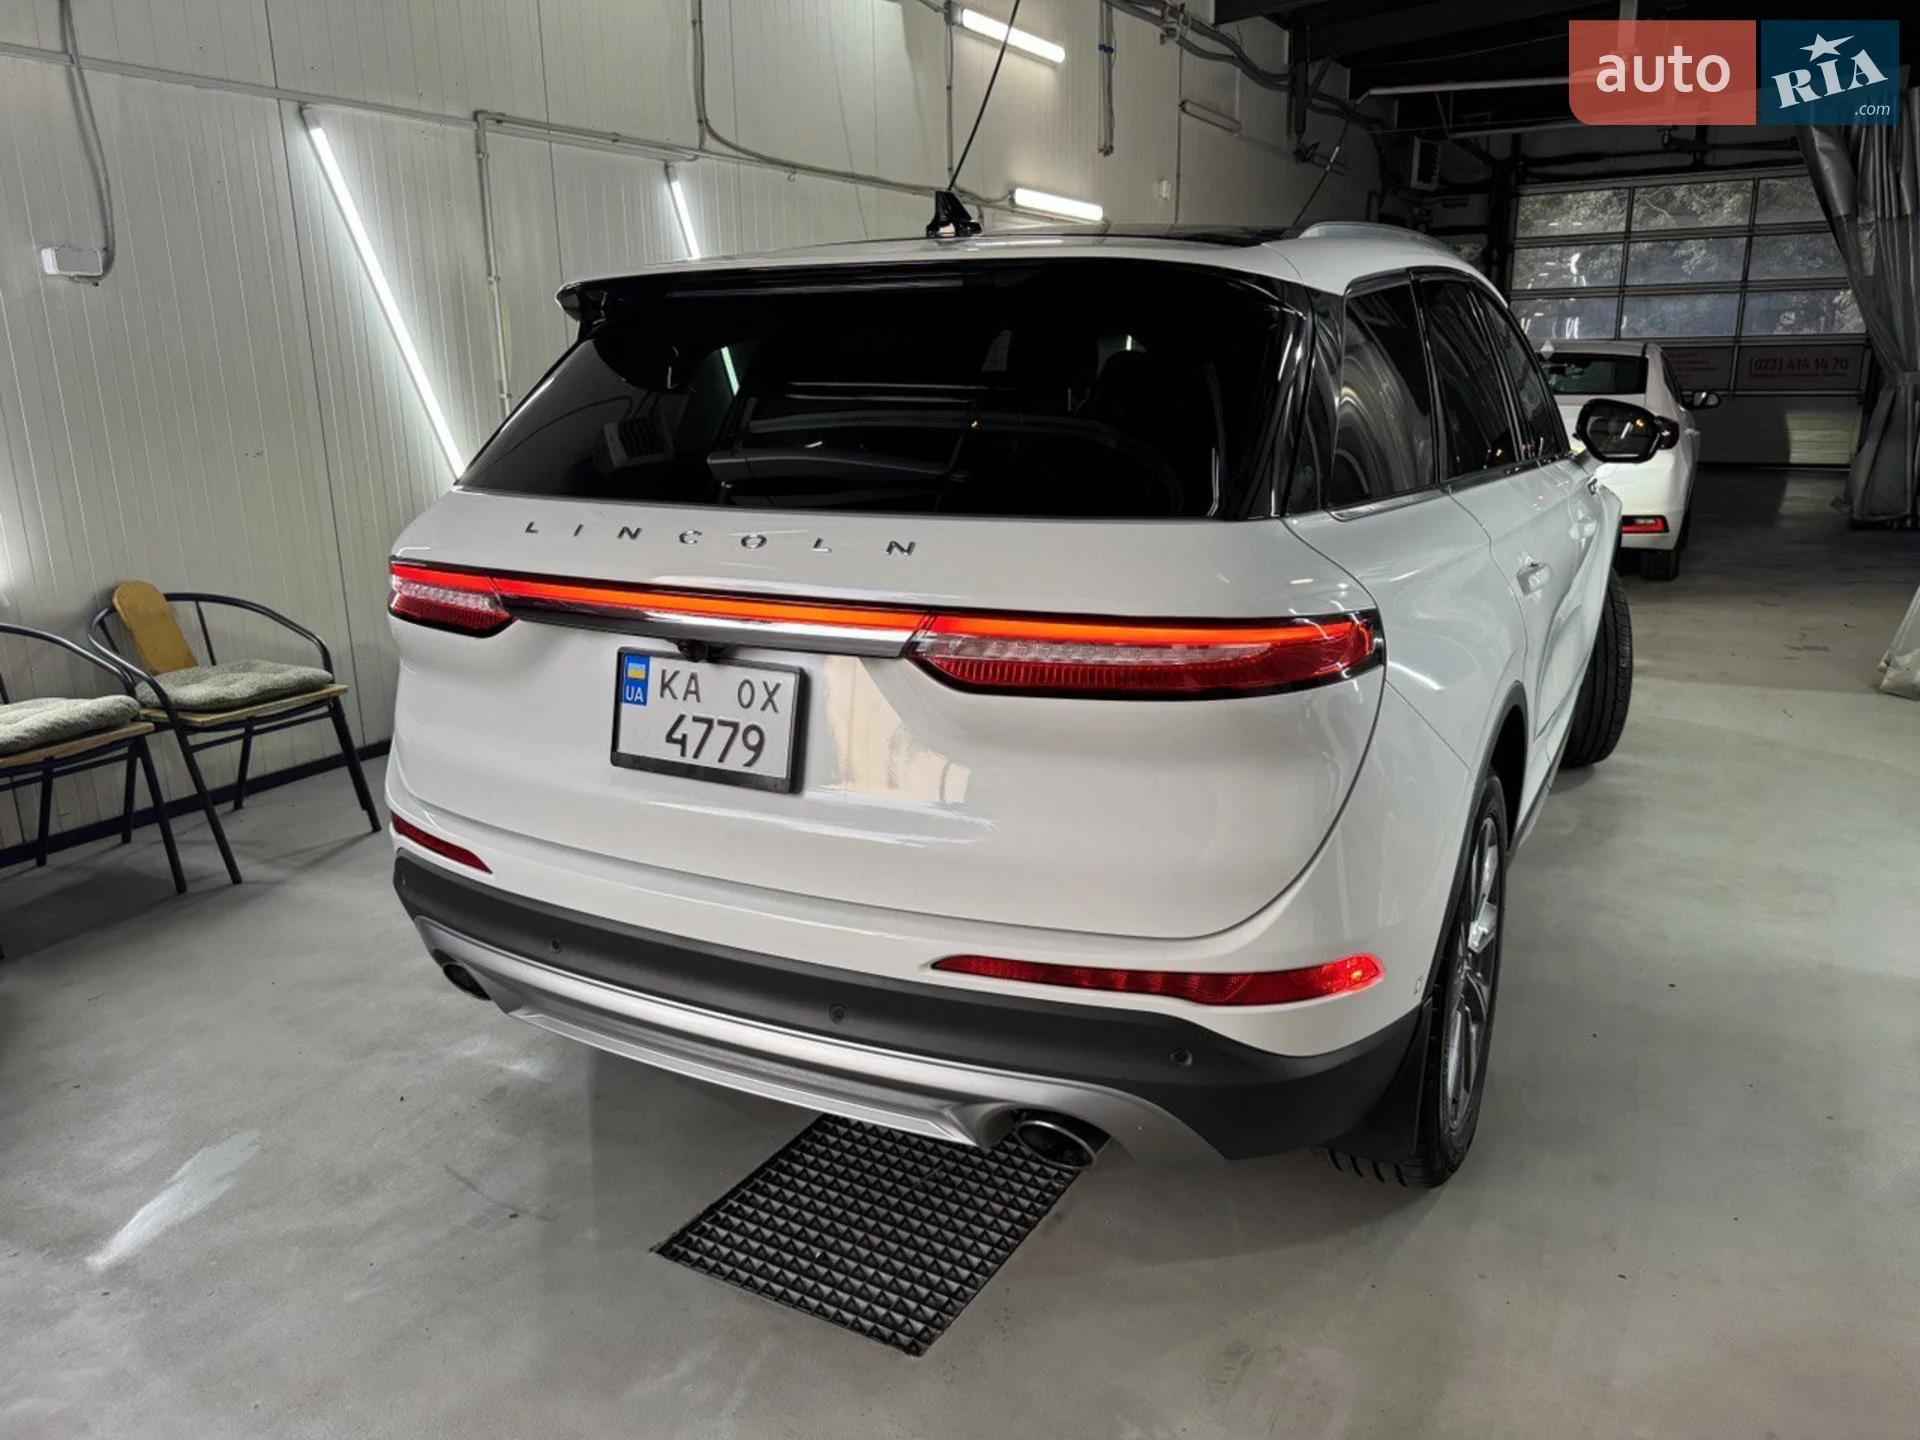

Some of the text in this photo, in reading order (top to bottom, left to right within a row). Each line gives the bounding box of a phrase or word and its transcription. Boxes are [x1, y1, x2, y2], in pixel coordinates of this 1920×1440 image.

[525, 521, 917, 556] LINCOLN
[625, 686, 644, 703] UA
[660, 669, 782, 713] KA OX
[665, 714, 765, 767] 4779
